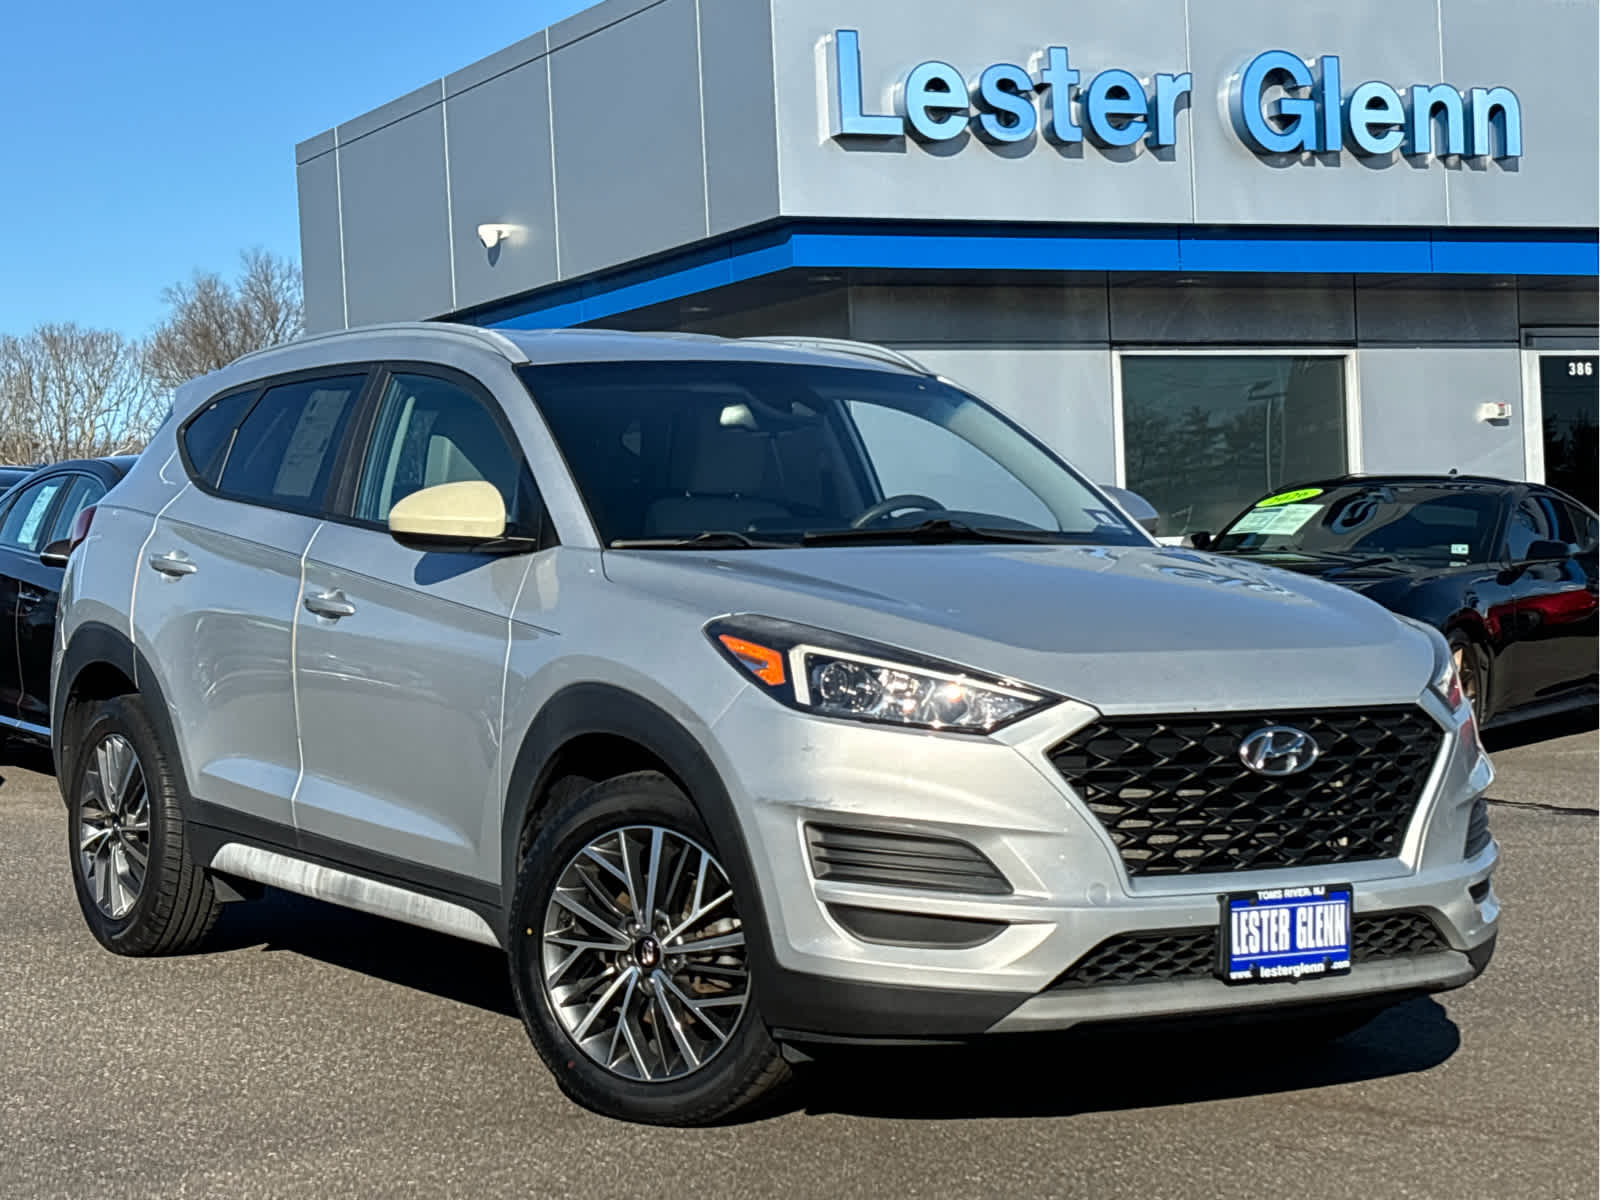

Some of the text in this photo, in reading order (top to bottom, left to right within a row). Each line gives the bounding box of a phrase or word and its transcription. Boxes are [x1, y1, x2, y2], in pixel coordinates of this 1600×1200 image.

[834, 28, 1522, 158] Lester Glenn
[1568, 361, 1593, 376] 386
[1257, 889, 1283, 901] TOMS
[1231, 903, 1346, 955] LESTER GLENN
[1260, 962, 1325, 978] lesterglenn
